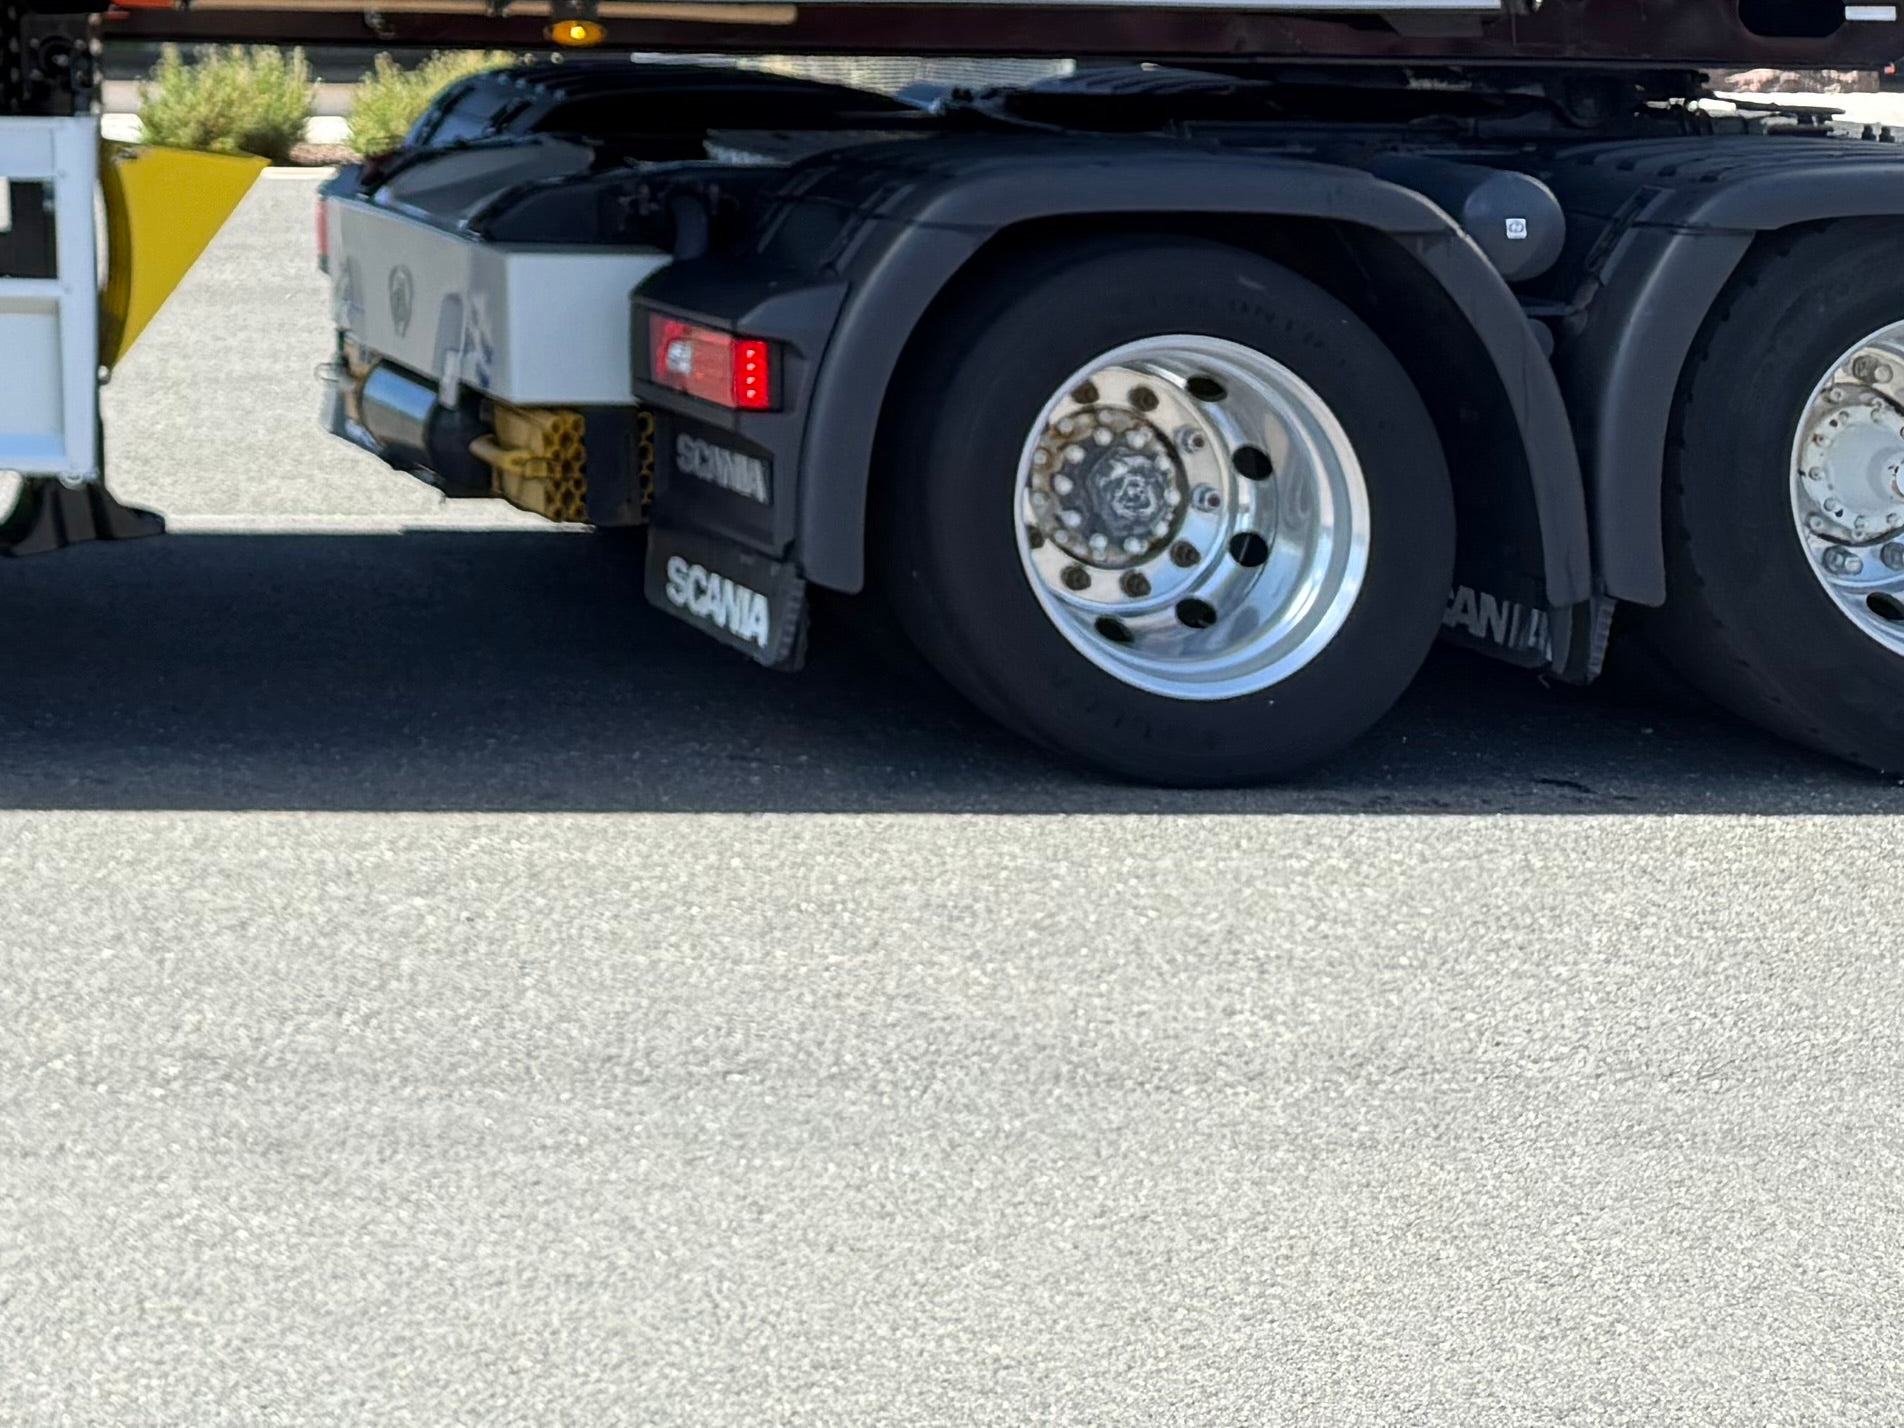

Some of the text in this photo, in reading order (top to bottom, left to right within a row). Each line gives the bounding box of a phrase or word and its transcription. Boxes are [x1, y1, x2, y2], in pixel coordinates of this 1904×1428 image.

[676, 432, 768, 505] SCANIA
[666, 555, 770, 649] SCANIA
[1442, 584, 1553, 662] ANIA
